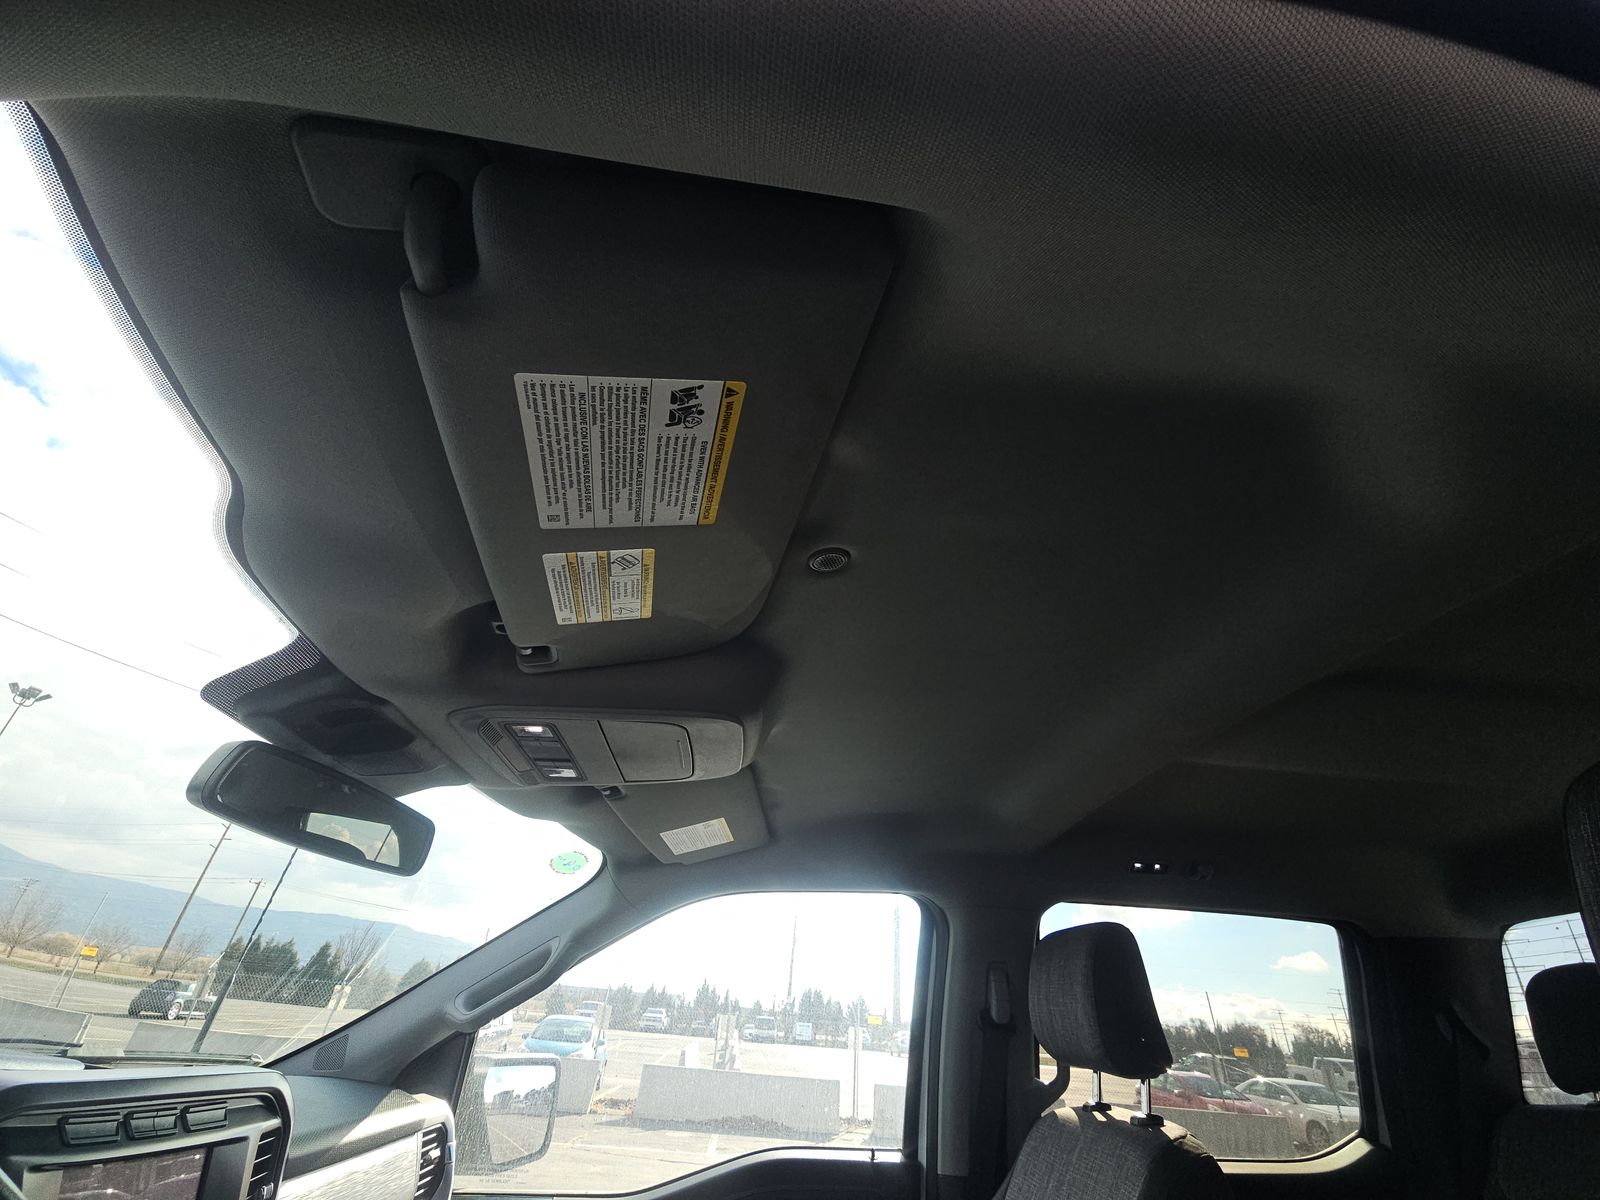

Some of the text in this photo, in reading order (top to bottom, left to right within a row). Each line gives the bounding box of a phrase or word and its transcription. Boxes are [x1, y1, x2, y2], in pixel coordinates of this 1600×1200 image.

[639, 386, 648, 405] MÊME
[577, 392, 587, 425] INCLUSIVE
[638, 406, 647, 422] AVEC
[720, 400, 734, 432] WARNING
[580, 426, 588, 439] CON
[638, 424, 646, 436] DES
[637, 437, 645, 452] SACS
[699, 440, 708, 454] EVEN
[581, 452, 590, 473] NUEVAS
[636, 453, 644, 486] GONFLABLES
[696, 456, 705, 468] WITH
[692, 469, 702, 494] ADVANCED
